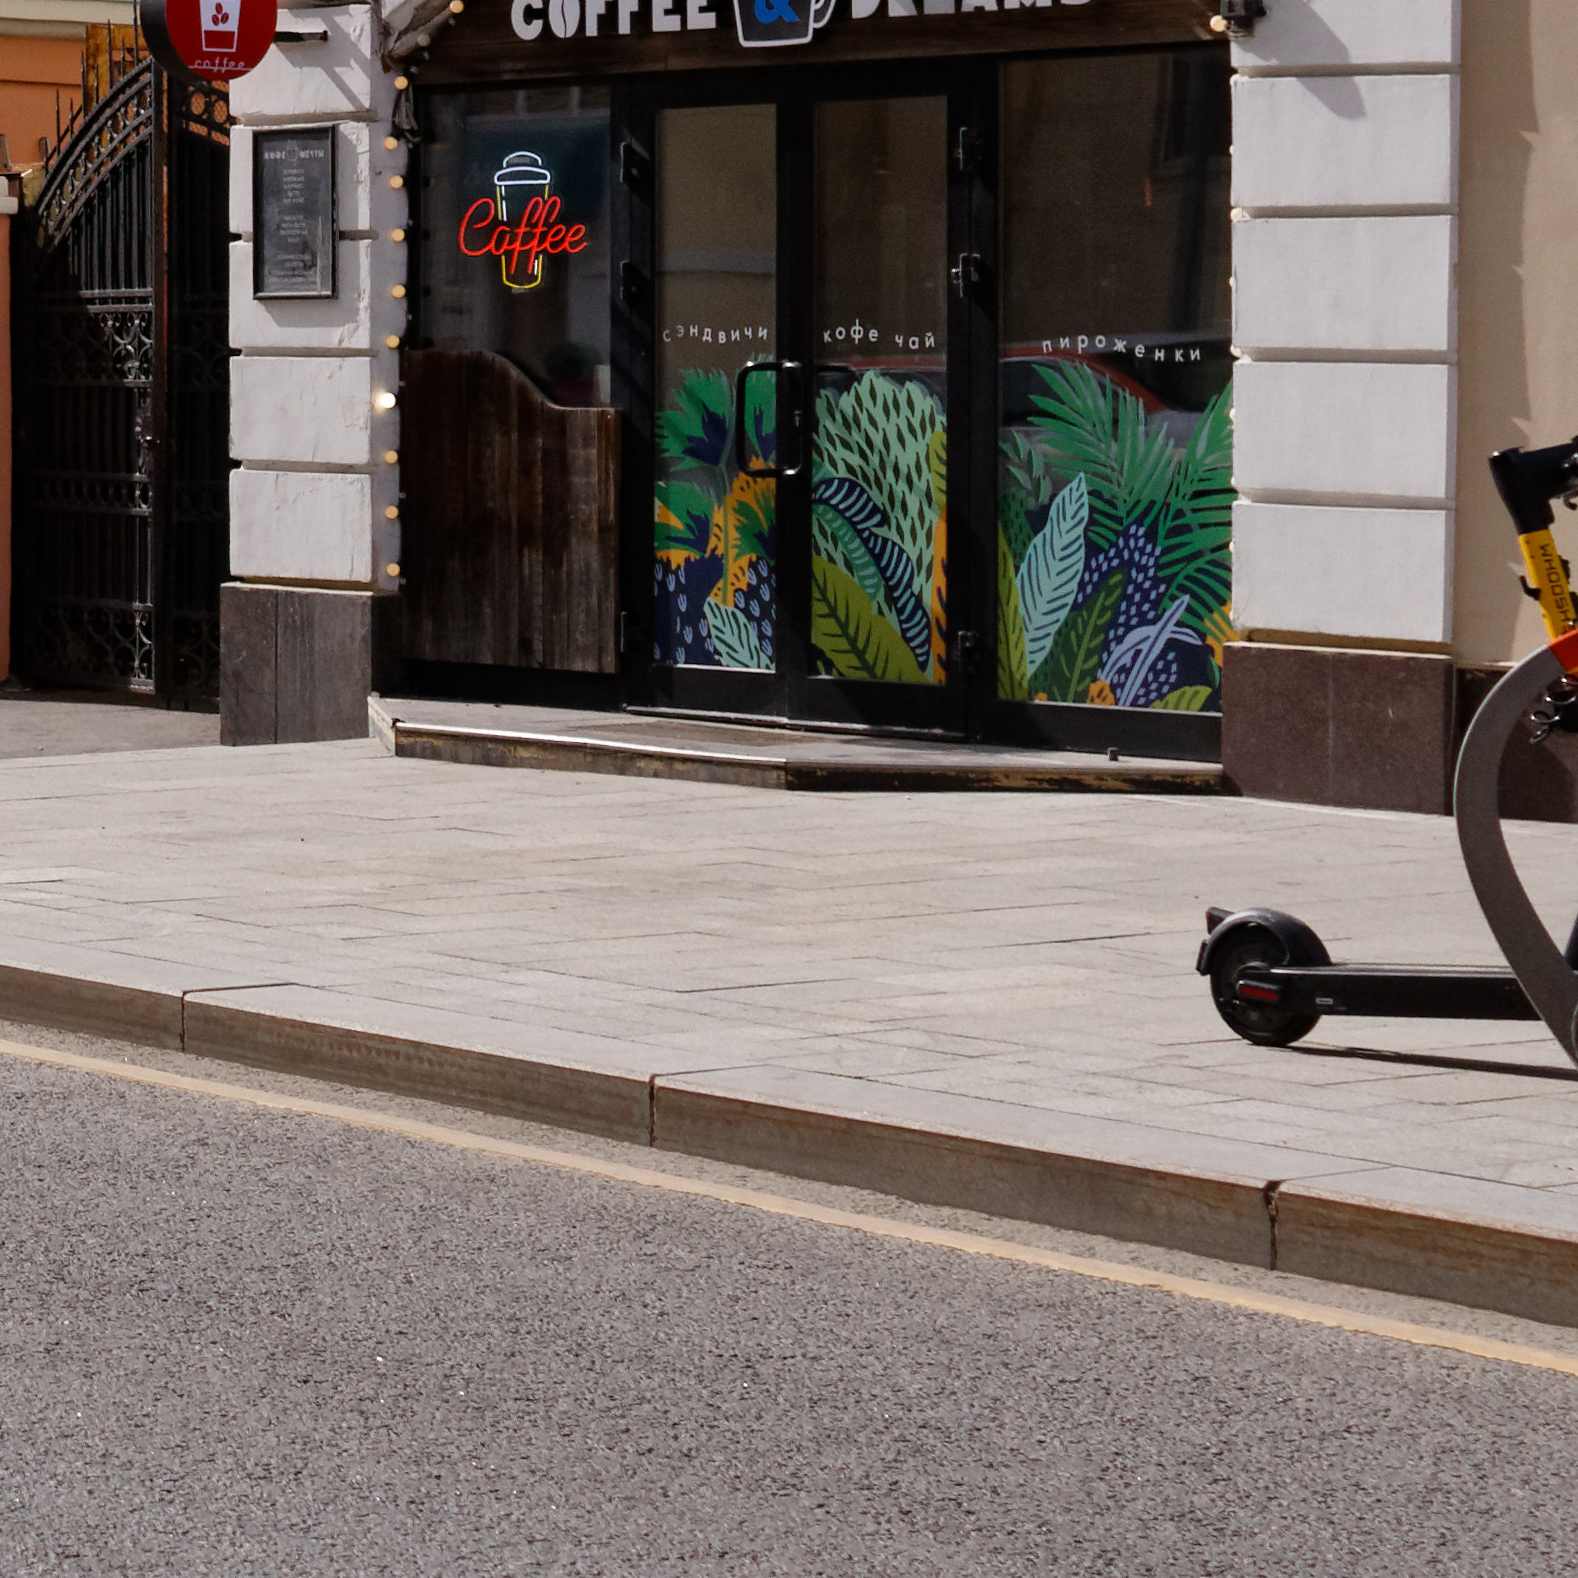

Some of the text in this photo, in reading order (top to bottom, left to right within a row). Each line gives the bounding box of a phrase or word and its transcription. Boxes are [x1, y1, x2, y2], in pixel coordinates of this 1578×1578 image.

[194, 57, 245, 73] coffee
[458, 195, 589, 275] Coffee
[662, 324, 768, 344] сэндвичи
[823, 318, 935, 349] кофе чай
[1042, 334, 1201, 363] пироженки
